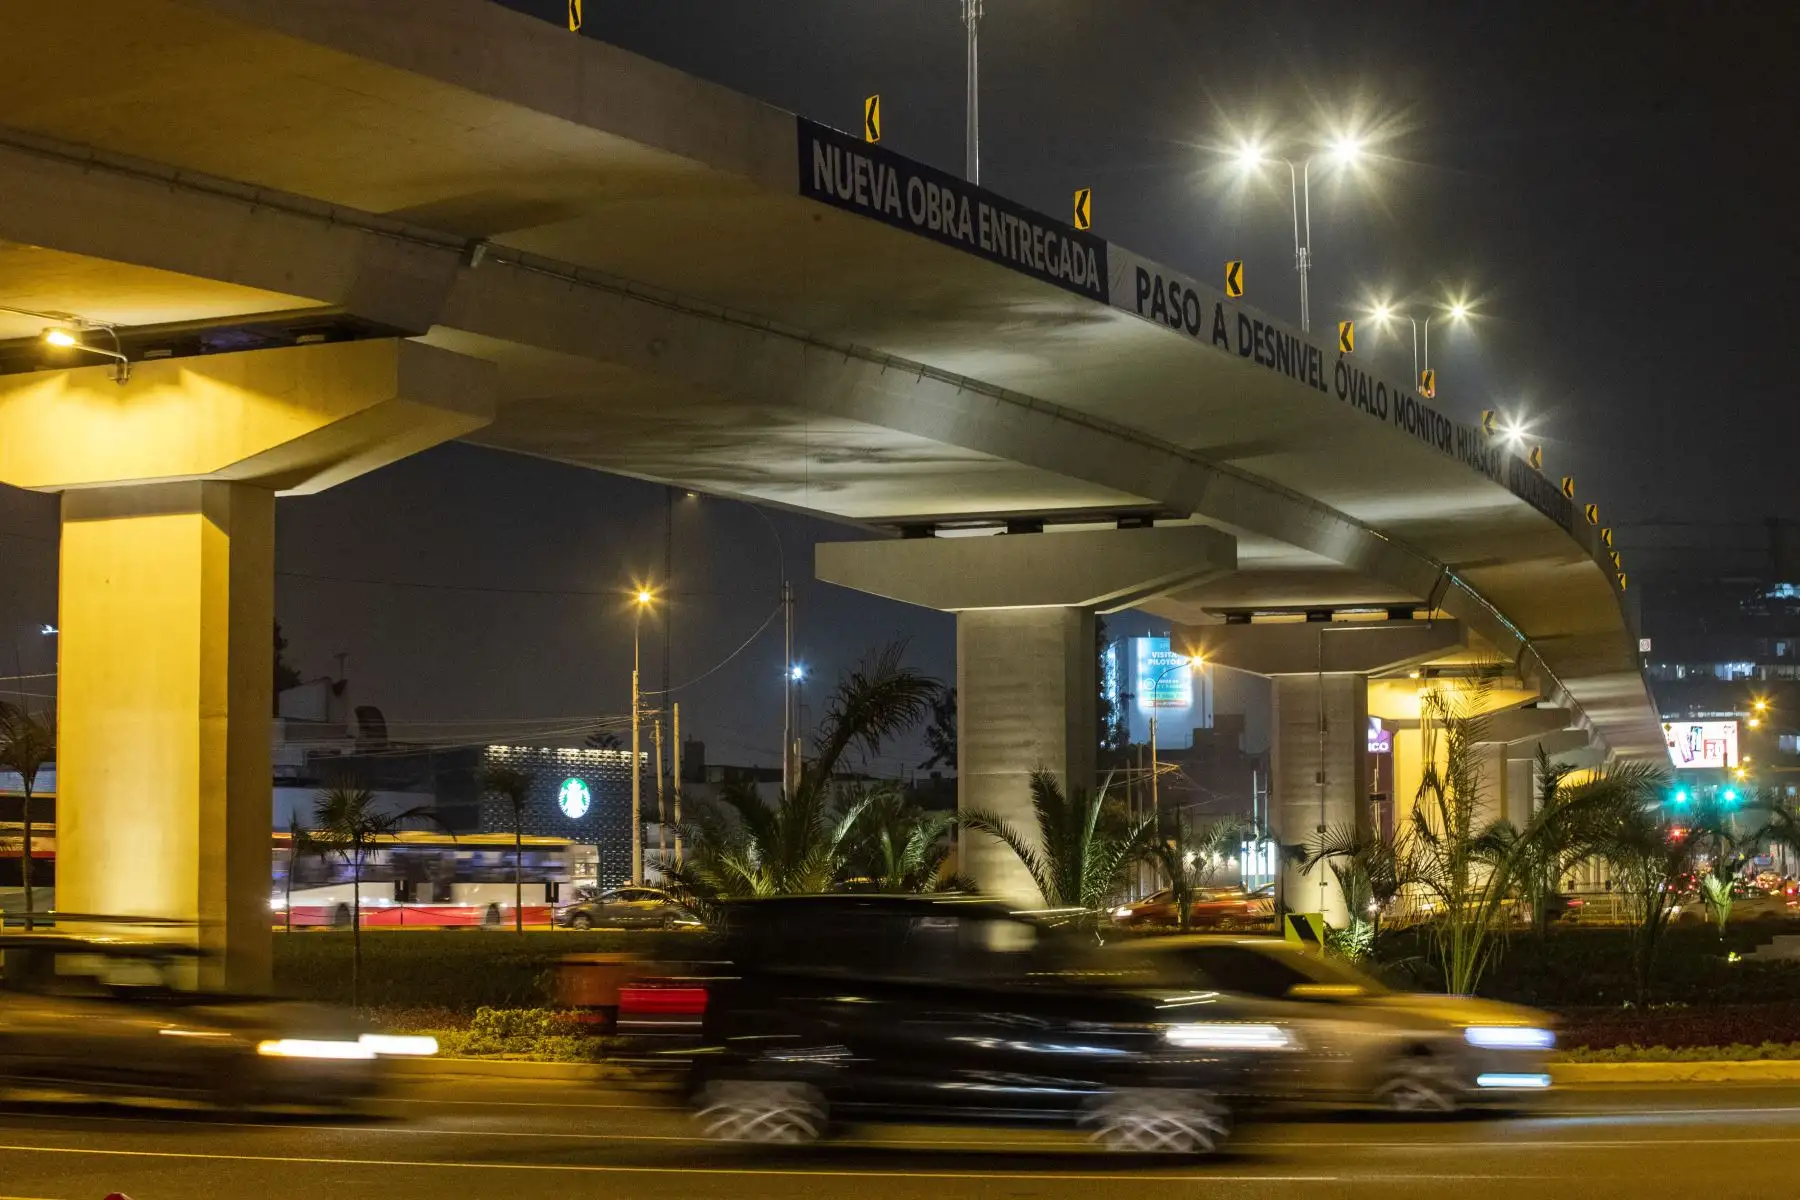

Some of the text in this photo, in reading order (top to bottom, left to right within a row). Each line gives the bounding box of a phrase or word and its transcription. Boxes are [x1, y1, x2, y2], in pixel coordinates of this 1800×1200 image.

[812, 139, 1101, 293] NUEVA OBRA ENTREGADA
[1136, 266, 1200, 336] PASO
[1212, 302, 1230, 351] A
[1238, 311, 1328, 393] DESNIVEL
[1334, 352, 1388, 421] ÓVALO
[1394, 389, 1453, 455] MONITOR
